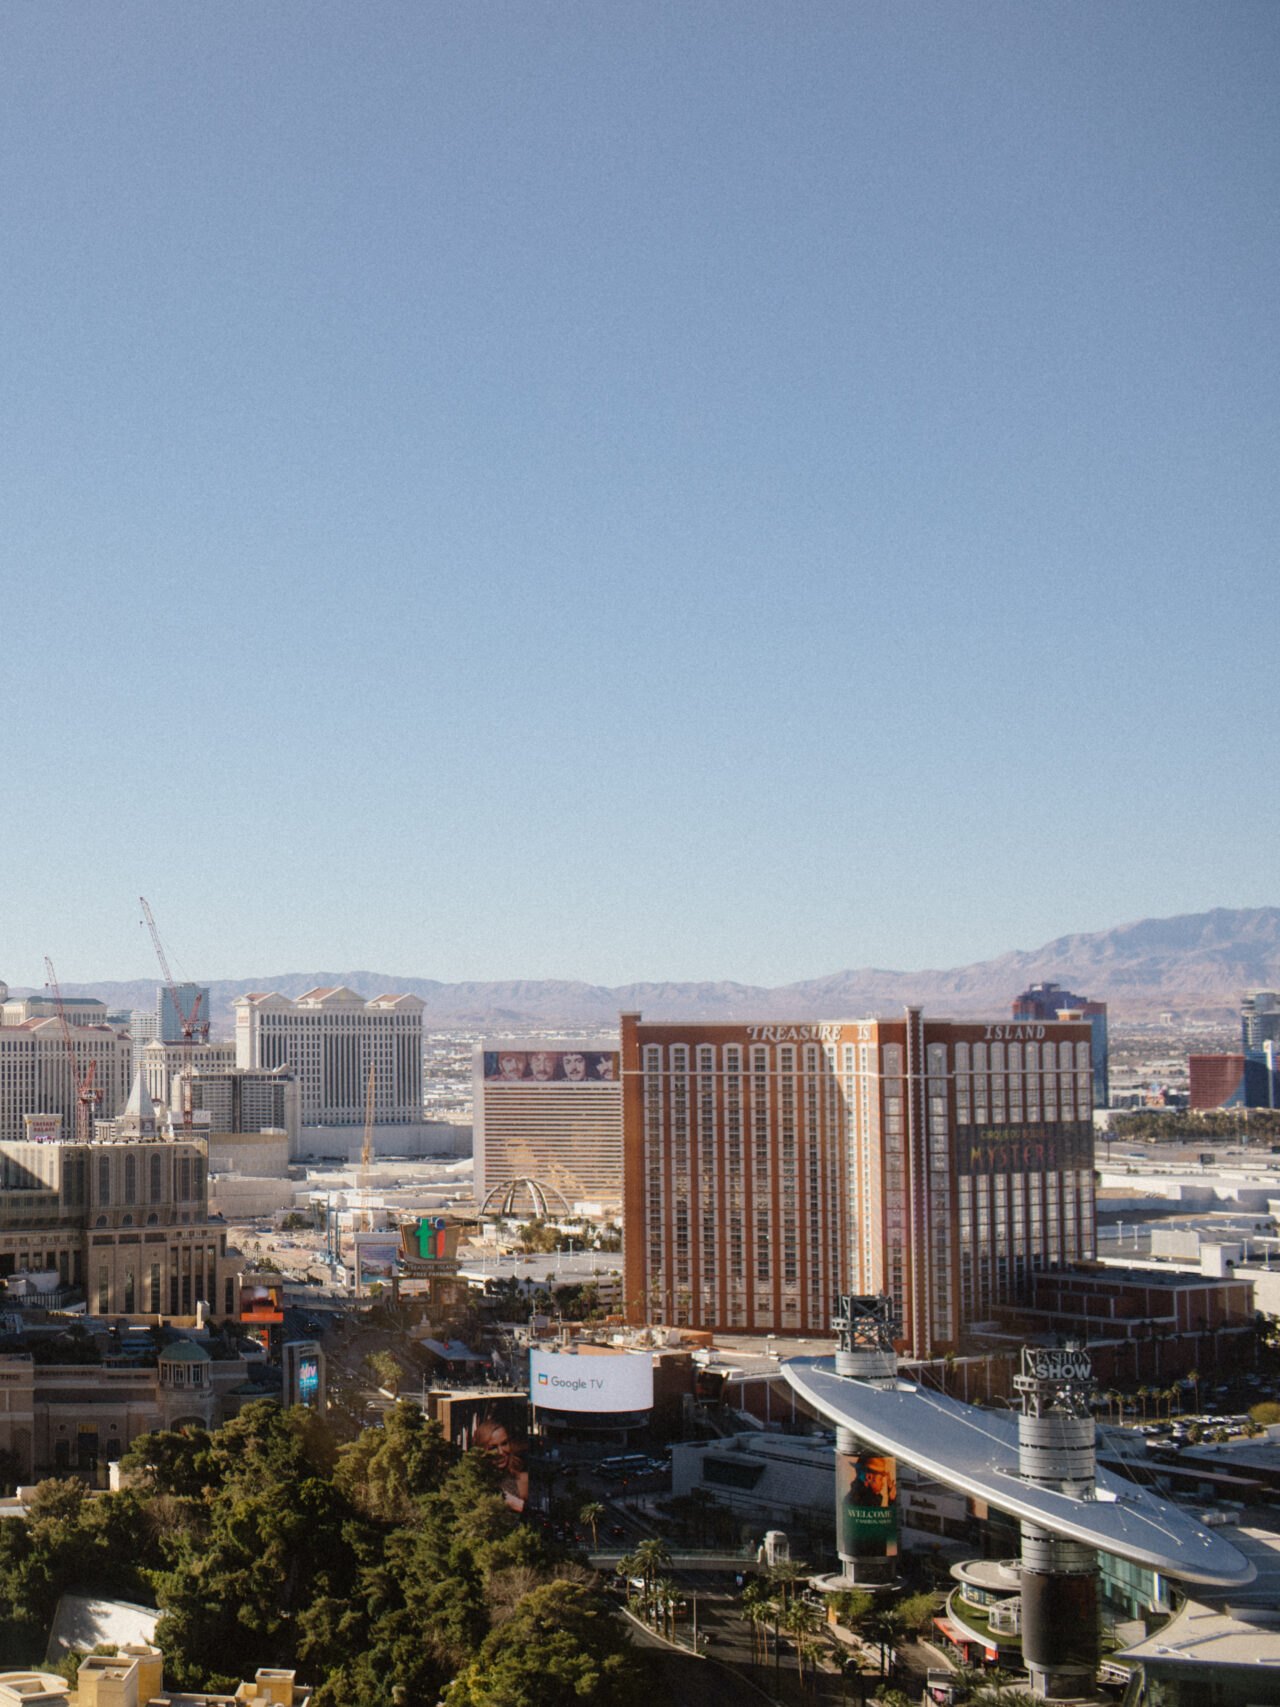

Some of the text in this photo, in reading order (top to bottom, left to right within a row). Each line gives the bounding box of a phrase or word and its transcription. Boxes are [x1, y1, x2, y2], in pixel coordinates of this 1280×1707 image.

[746, 1025, 841, 1042] TREASURE
[984, 1025, 1046, 1040] ISLAND
[1036, 1351, 1091, 1365] FASHION
[1036, 1364, 1091, 1379] SHOW
[551, 1376, 603, 1391] Google TV
[848, 1510, 891, 1519] WELCOME
